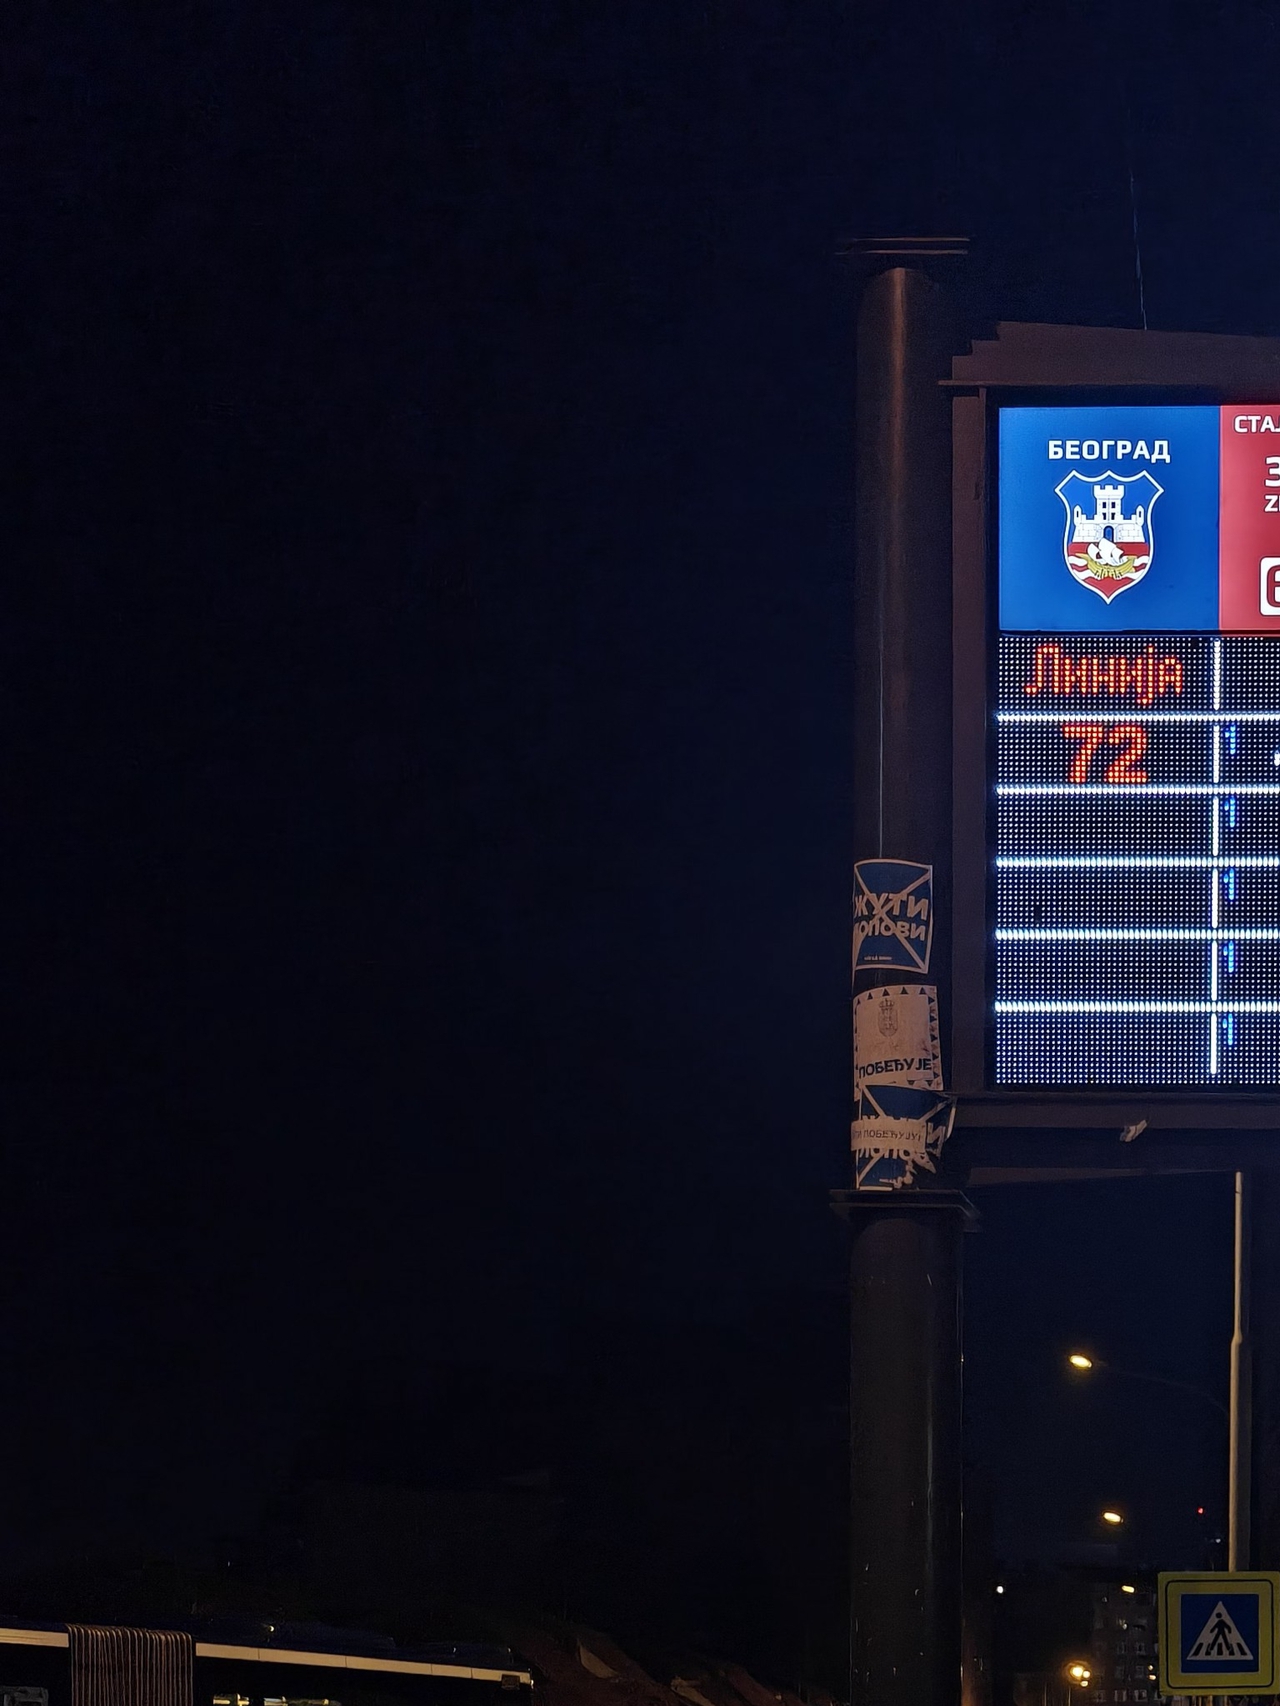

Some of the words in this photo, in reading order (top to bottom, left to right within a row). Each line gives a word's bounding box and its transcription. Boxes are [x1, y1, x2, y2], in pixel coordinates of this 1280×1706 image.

[1048, 440, 1172, 464] БЕОГРАД
[1024, 645, 1184, 705] Линија
[1063, 724, 1149, 783] 72
